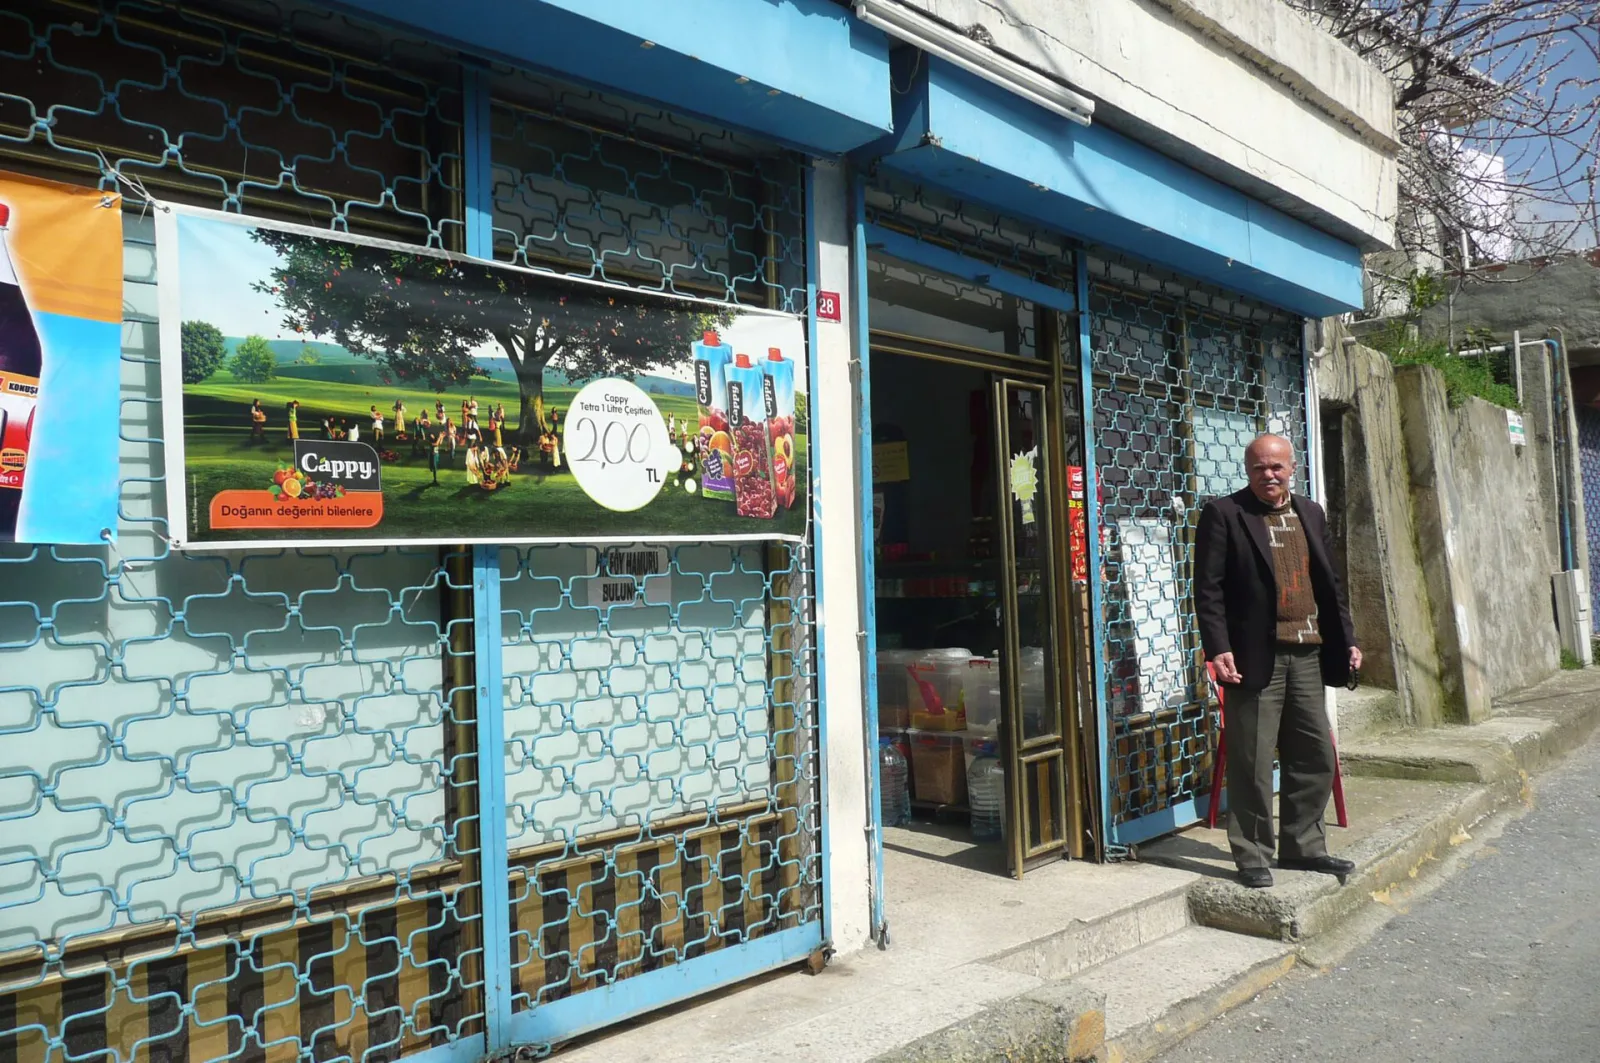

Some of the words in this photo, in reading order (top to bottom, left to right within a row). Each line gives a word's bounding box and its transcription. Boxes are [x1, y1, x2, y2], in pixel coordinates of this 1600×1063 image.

[819, 298, 834, 314] 28
[699, 362, 708, 404] Cappy
[580, 402, 600, 412] Tetra
[607, 404, 622, 414] Litre
[624, 405, 653, 416] Çeşitleri
[604, 393, 629, 405] Cappy
[731, 384, 740, 424] Cappy
[764, 378, 774, 416] Cappy
[574, 417, 651, 469] 2,00
[301, 452, 373, 479] Cappy
[646, 468, 660, 483] TL
[221, 505, 273, 519] Doğanın
[276, 505, 324, 519] değerini
[327, 506, 373, 517] bilenlere
[626, 551, 659, 576] HAMURU
